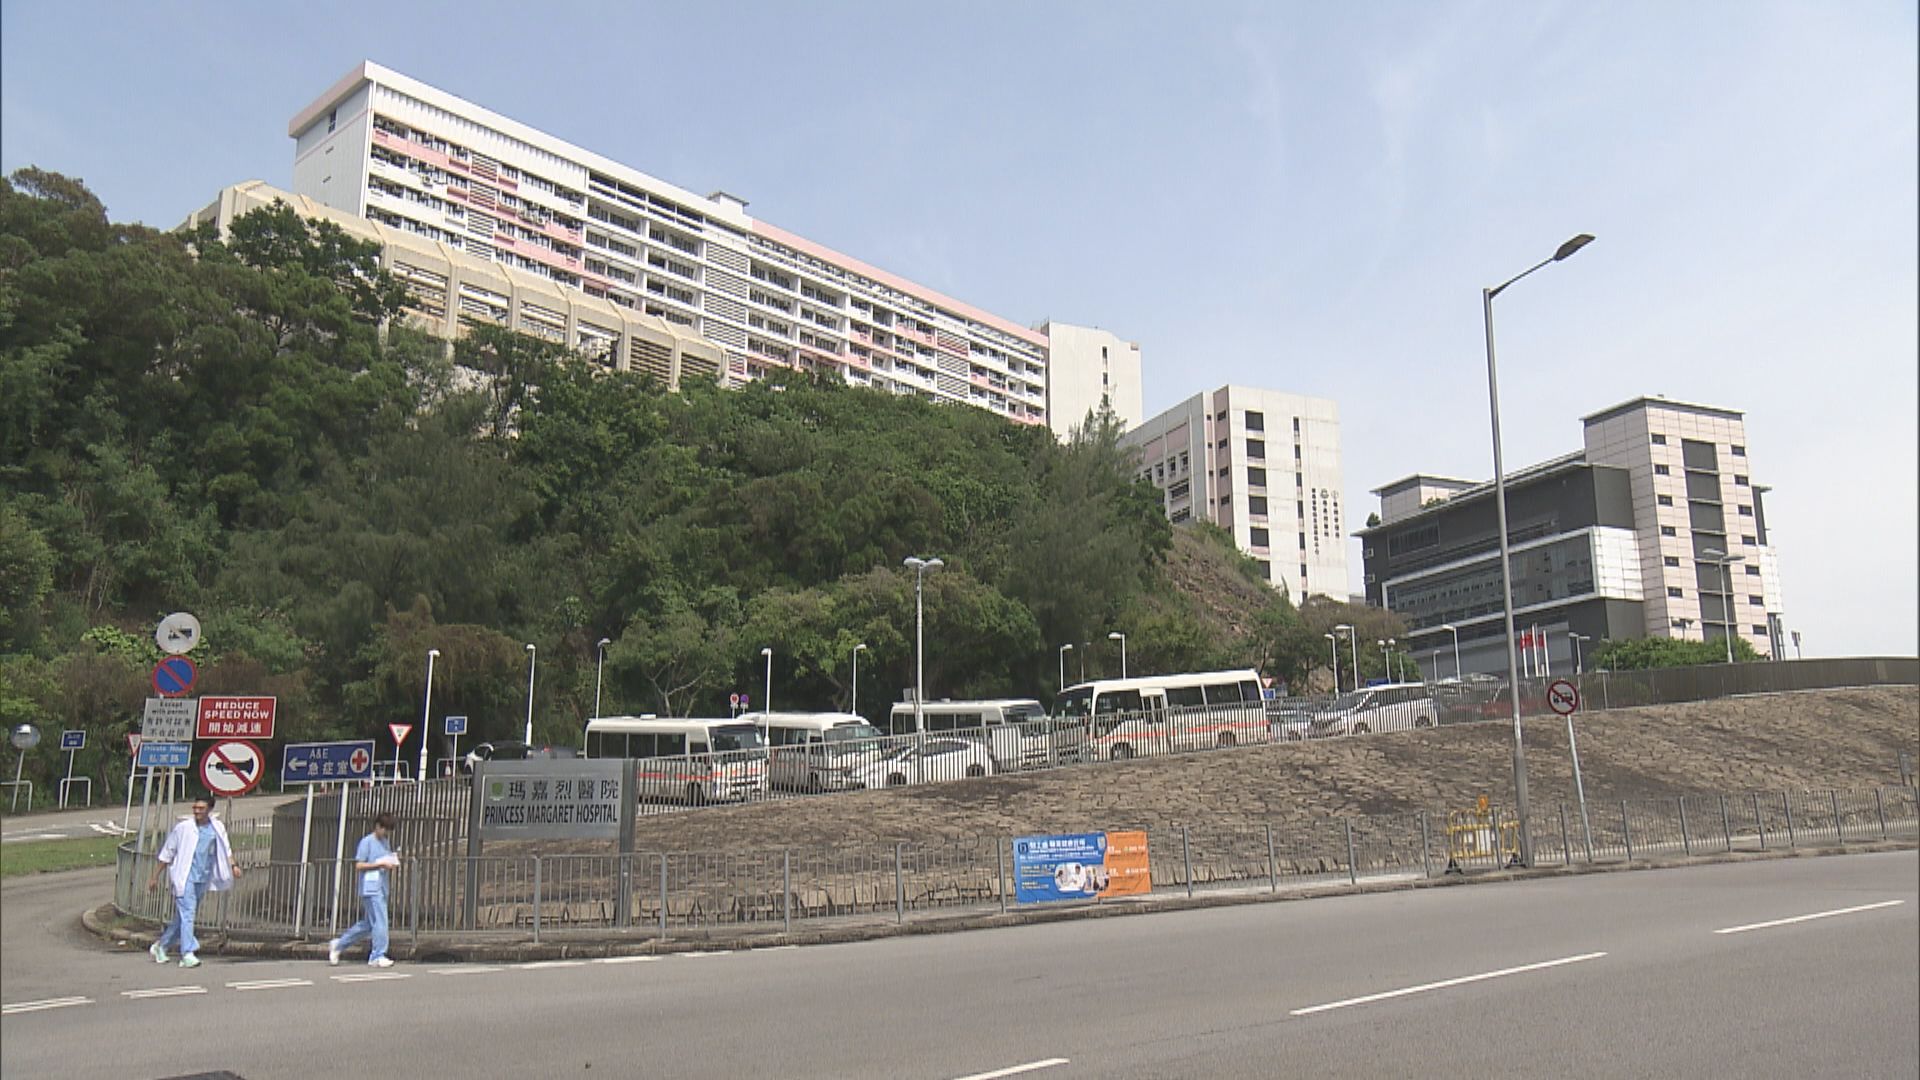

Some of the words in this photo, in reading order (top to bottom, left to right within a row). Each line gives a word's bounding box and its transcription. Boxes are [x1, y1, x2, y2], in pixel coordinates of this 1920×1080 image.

[215, 701, 260, 709] REDUCE
[204, 710, 241, 719] SPEED
[243, 710, 269, 719] NOW
[208, 722, 262, 733] 開始減速
[309, 748, 329, 759] A&E
[307, 760, 349, 776] 急症室
[508, 779, 619, 801] 瑪嘉烈醫院
[484, 805, 525, 825] PRINCESS
[526, 804, 575, 824] MARGARET
[576, 803, 618, 823] HOSPITAL
